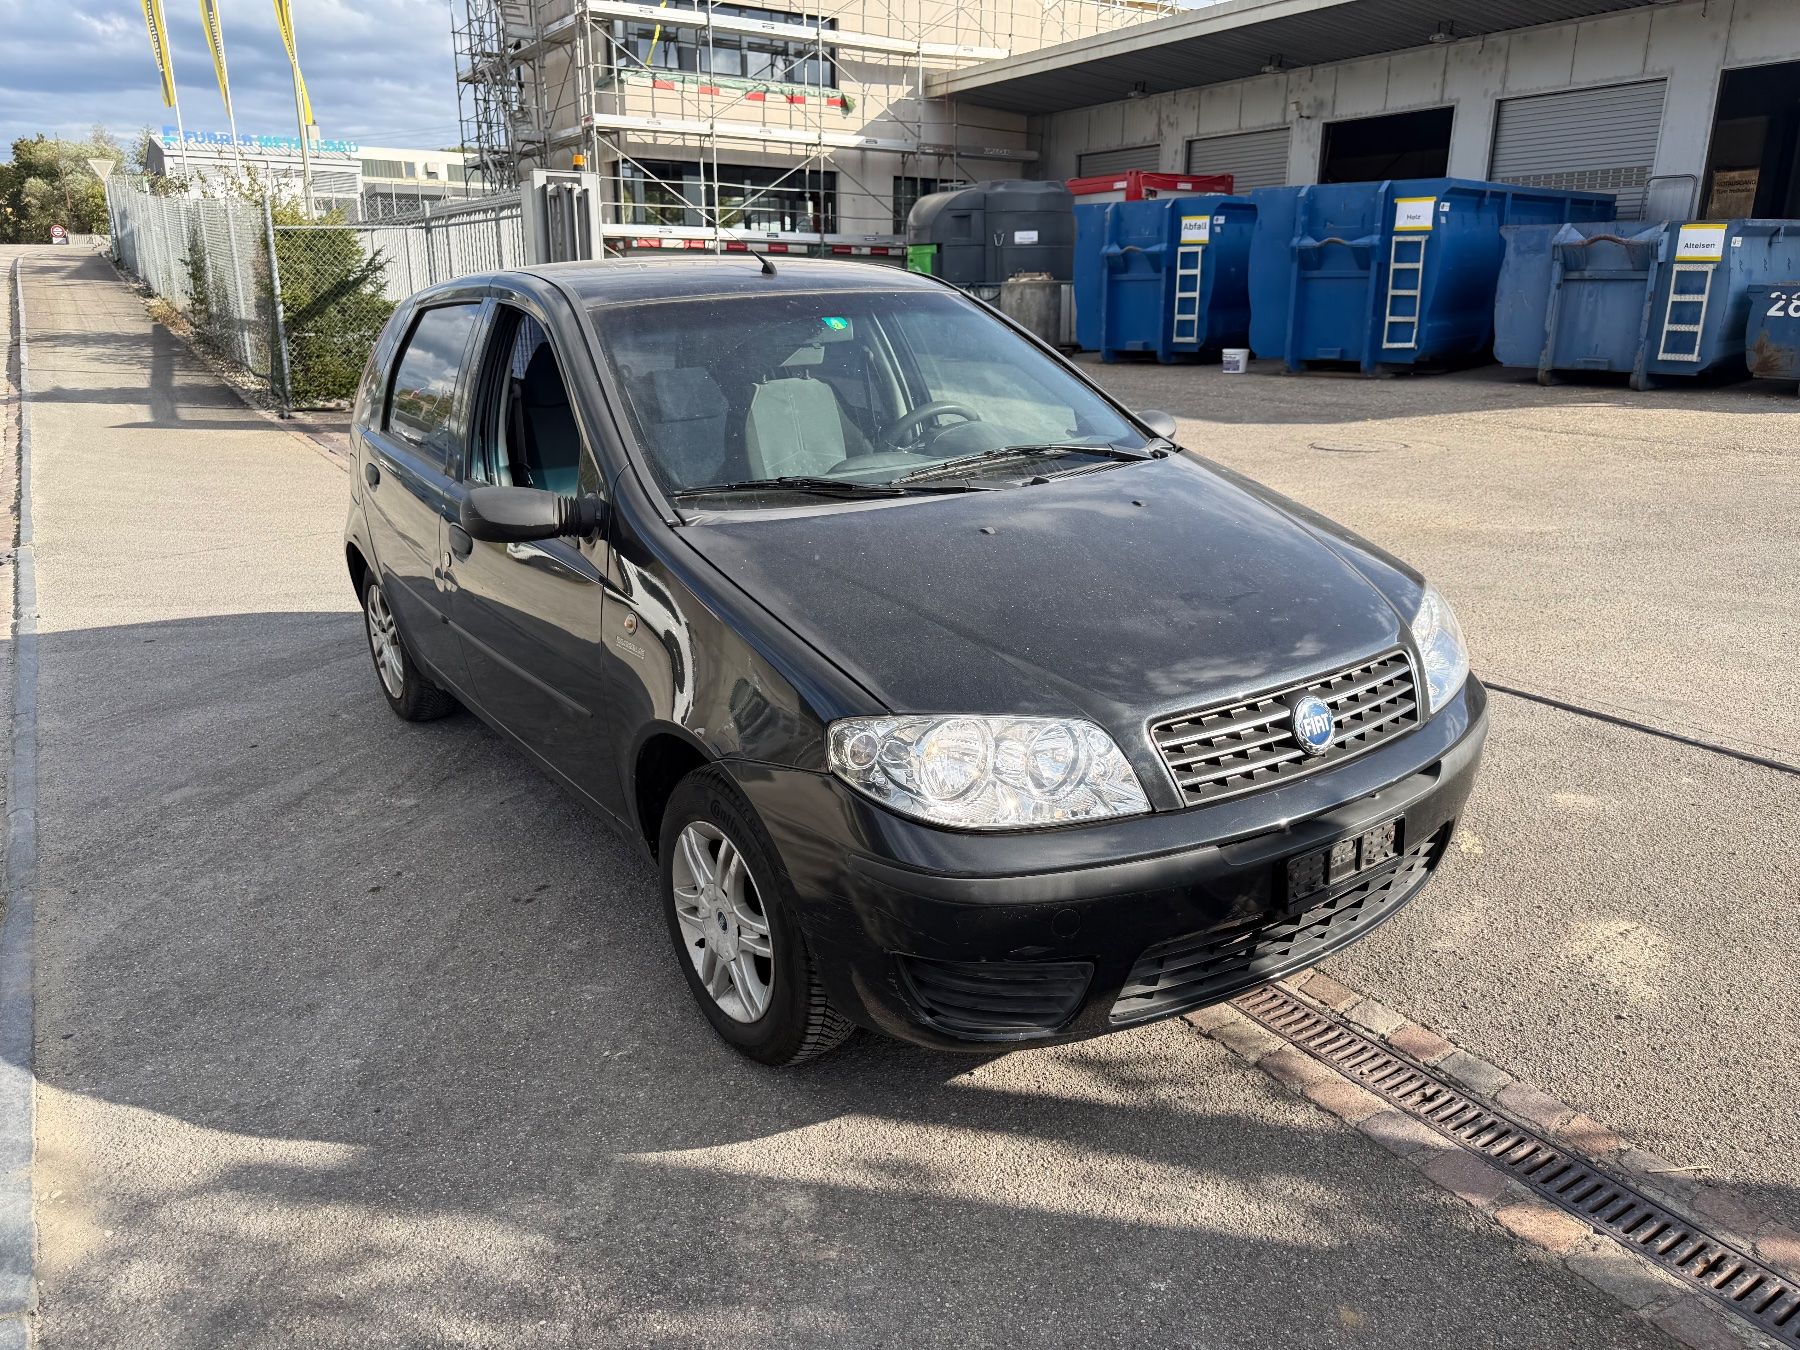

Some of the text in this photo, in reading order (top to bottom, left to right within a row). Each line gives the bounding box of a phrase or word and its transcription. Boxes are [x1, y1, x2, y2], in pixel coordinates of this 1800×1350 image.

[183, 130, 252, 146] FURRR
[1183, 222, 1208, 231] Abfall
[1303, 713, 1331, 737] FIAT
